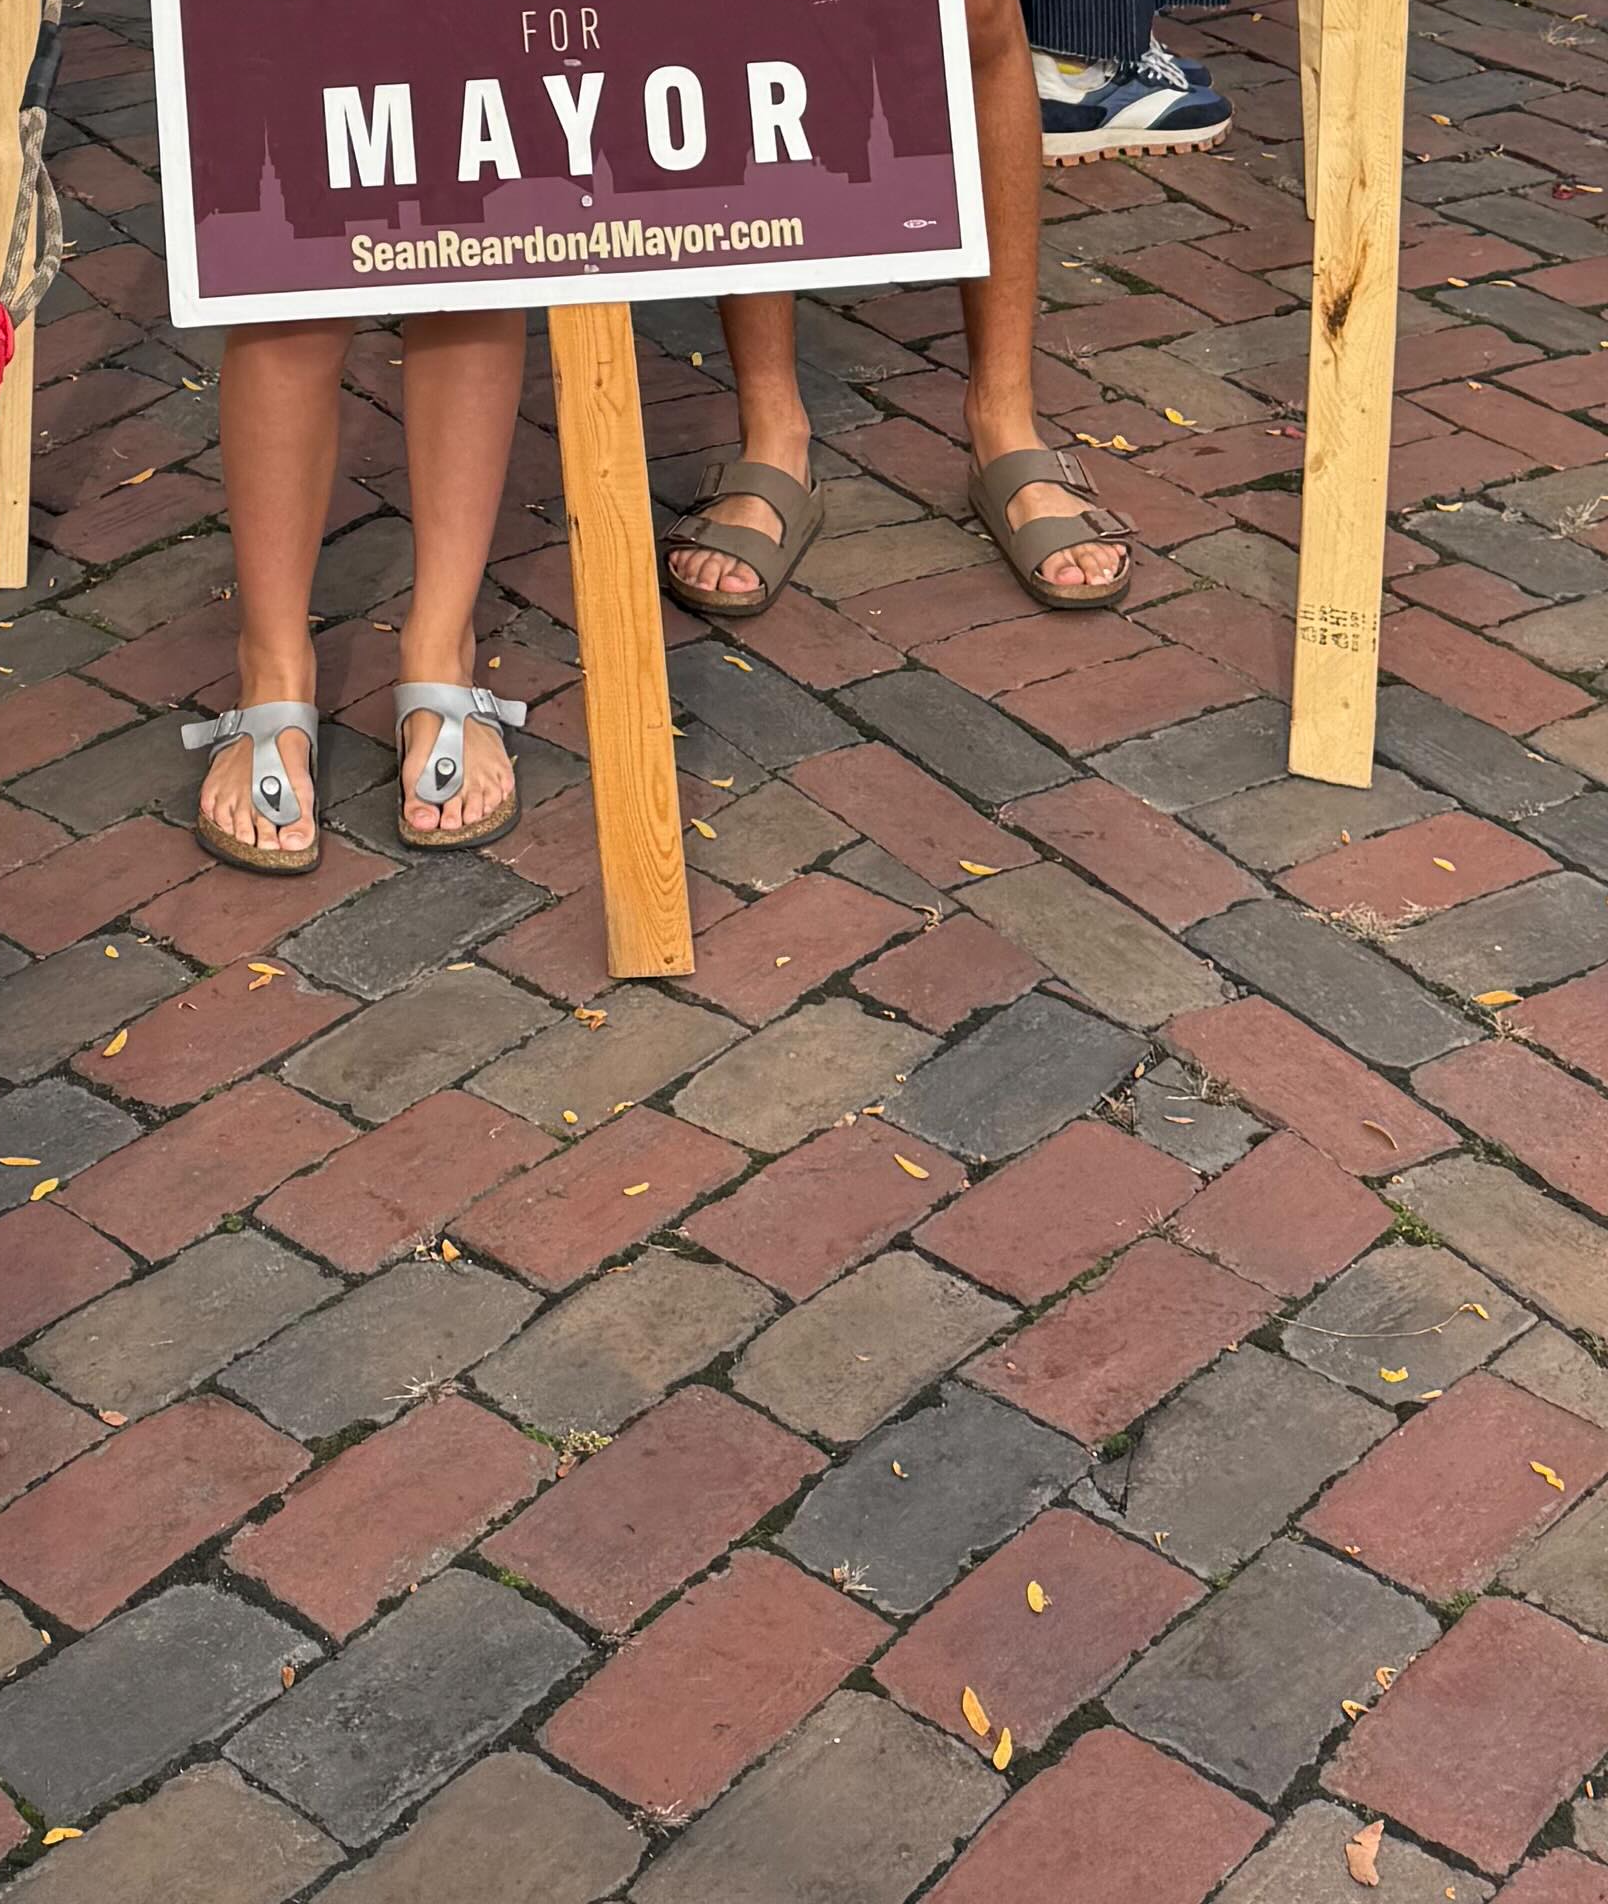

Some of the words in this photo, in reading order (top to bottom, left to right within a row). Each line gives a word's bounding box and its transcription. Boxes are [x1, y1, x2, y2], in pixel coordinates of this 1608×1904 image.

[522, 7, 601, 53] FOR
[322, 61, 813, 189] MAYOR
[351, 217, 804, 274] SeanReardon4Mayor.com
